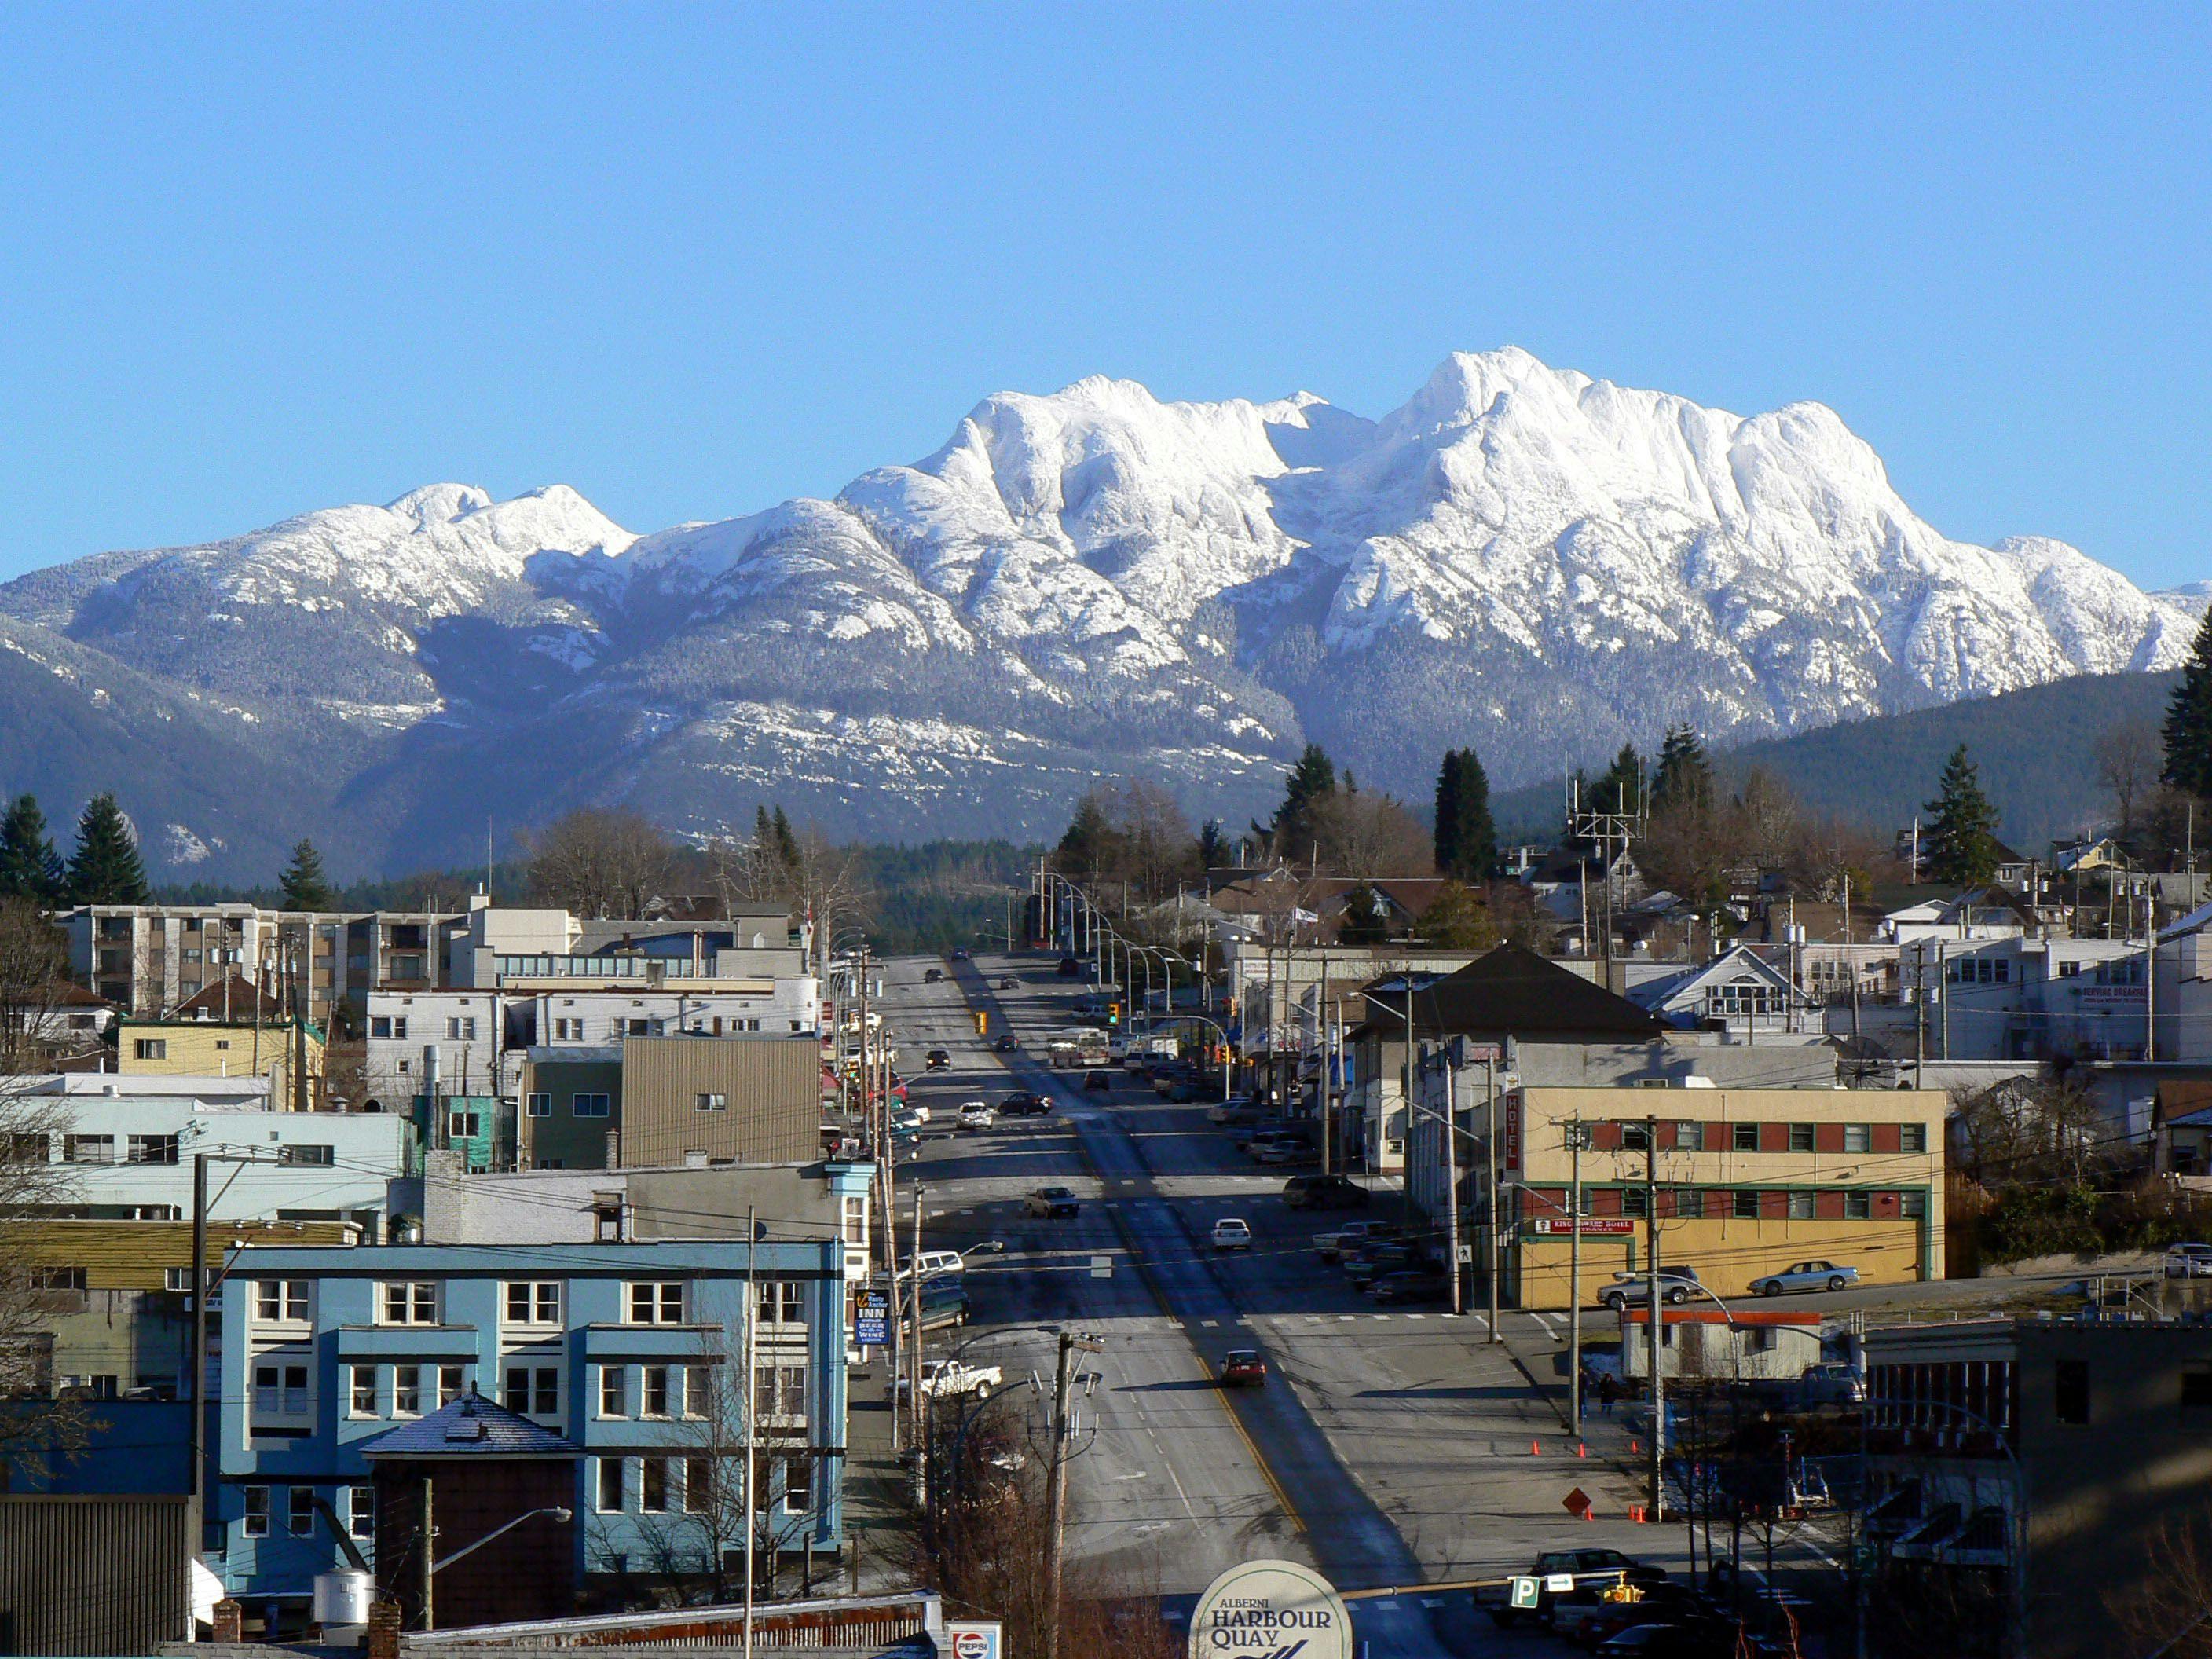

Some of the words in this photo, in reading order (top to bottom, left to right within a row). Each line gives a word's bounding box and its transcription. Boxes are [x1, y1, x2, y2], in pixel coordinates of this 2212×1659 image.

[1508, 1098, 1517, 1158] HOTEL
[859, 1309, 884, 1318] INN
[1518, 1580, 1534, 1604] P
[1220, 1599, 1268, 1608] ALBERNI
[1212, 1610, 1330, 1628] HARBOUR
[1210, 1629, 1279, 1650] QUAY
